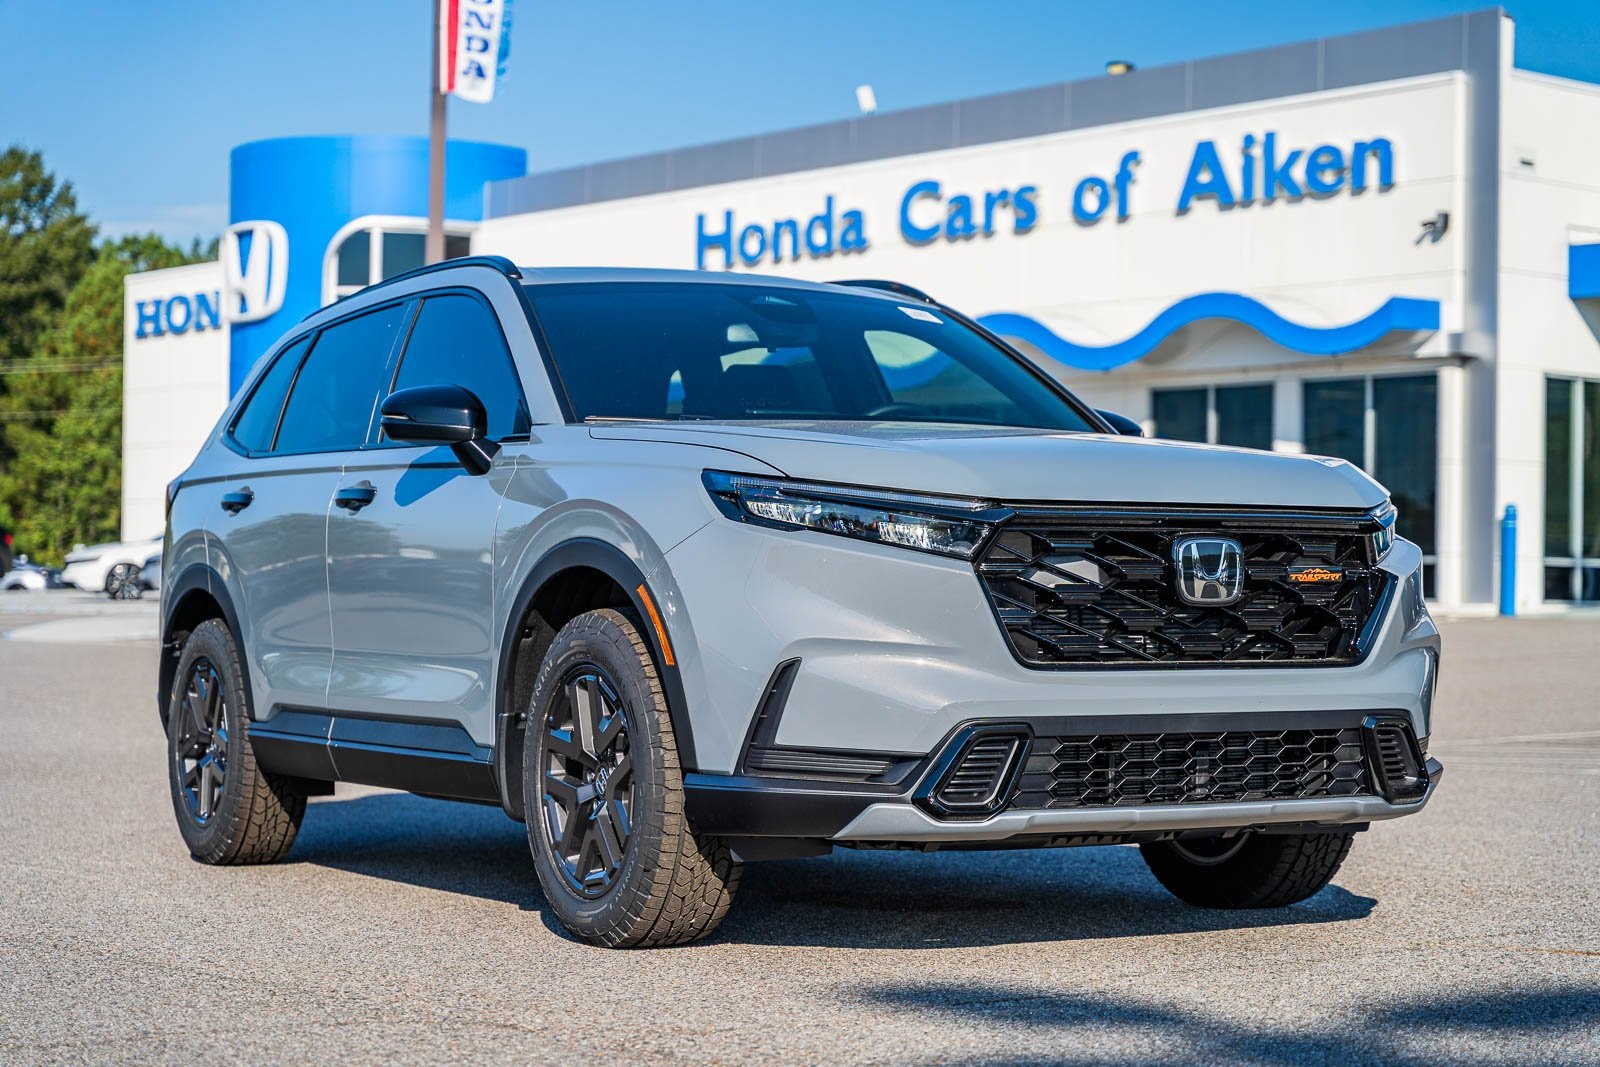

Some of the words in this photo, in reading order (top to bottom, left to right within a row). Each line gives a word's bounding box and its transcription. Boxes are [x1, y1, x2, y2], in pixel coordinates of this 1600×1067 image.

[463, 0, 494, 79] NDA
[697, 194, 868, 270] Honda
[900, 181, 1038, 244] Cars
[1072, 151, 1140, 222] of
[1176, 132, 1394, 212] Aiken
[1290, 572, 1342, 582] TRAILSPORT
